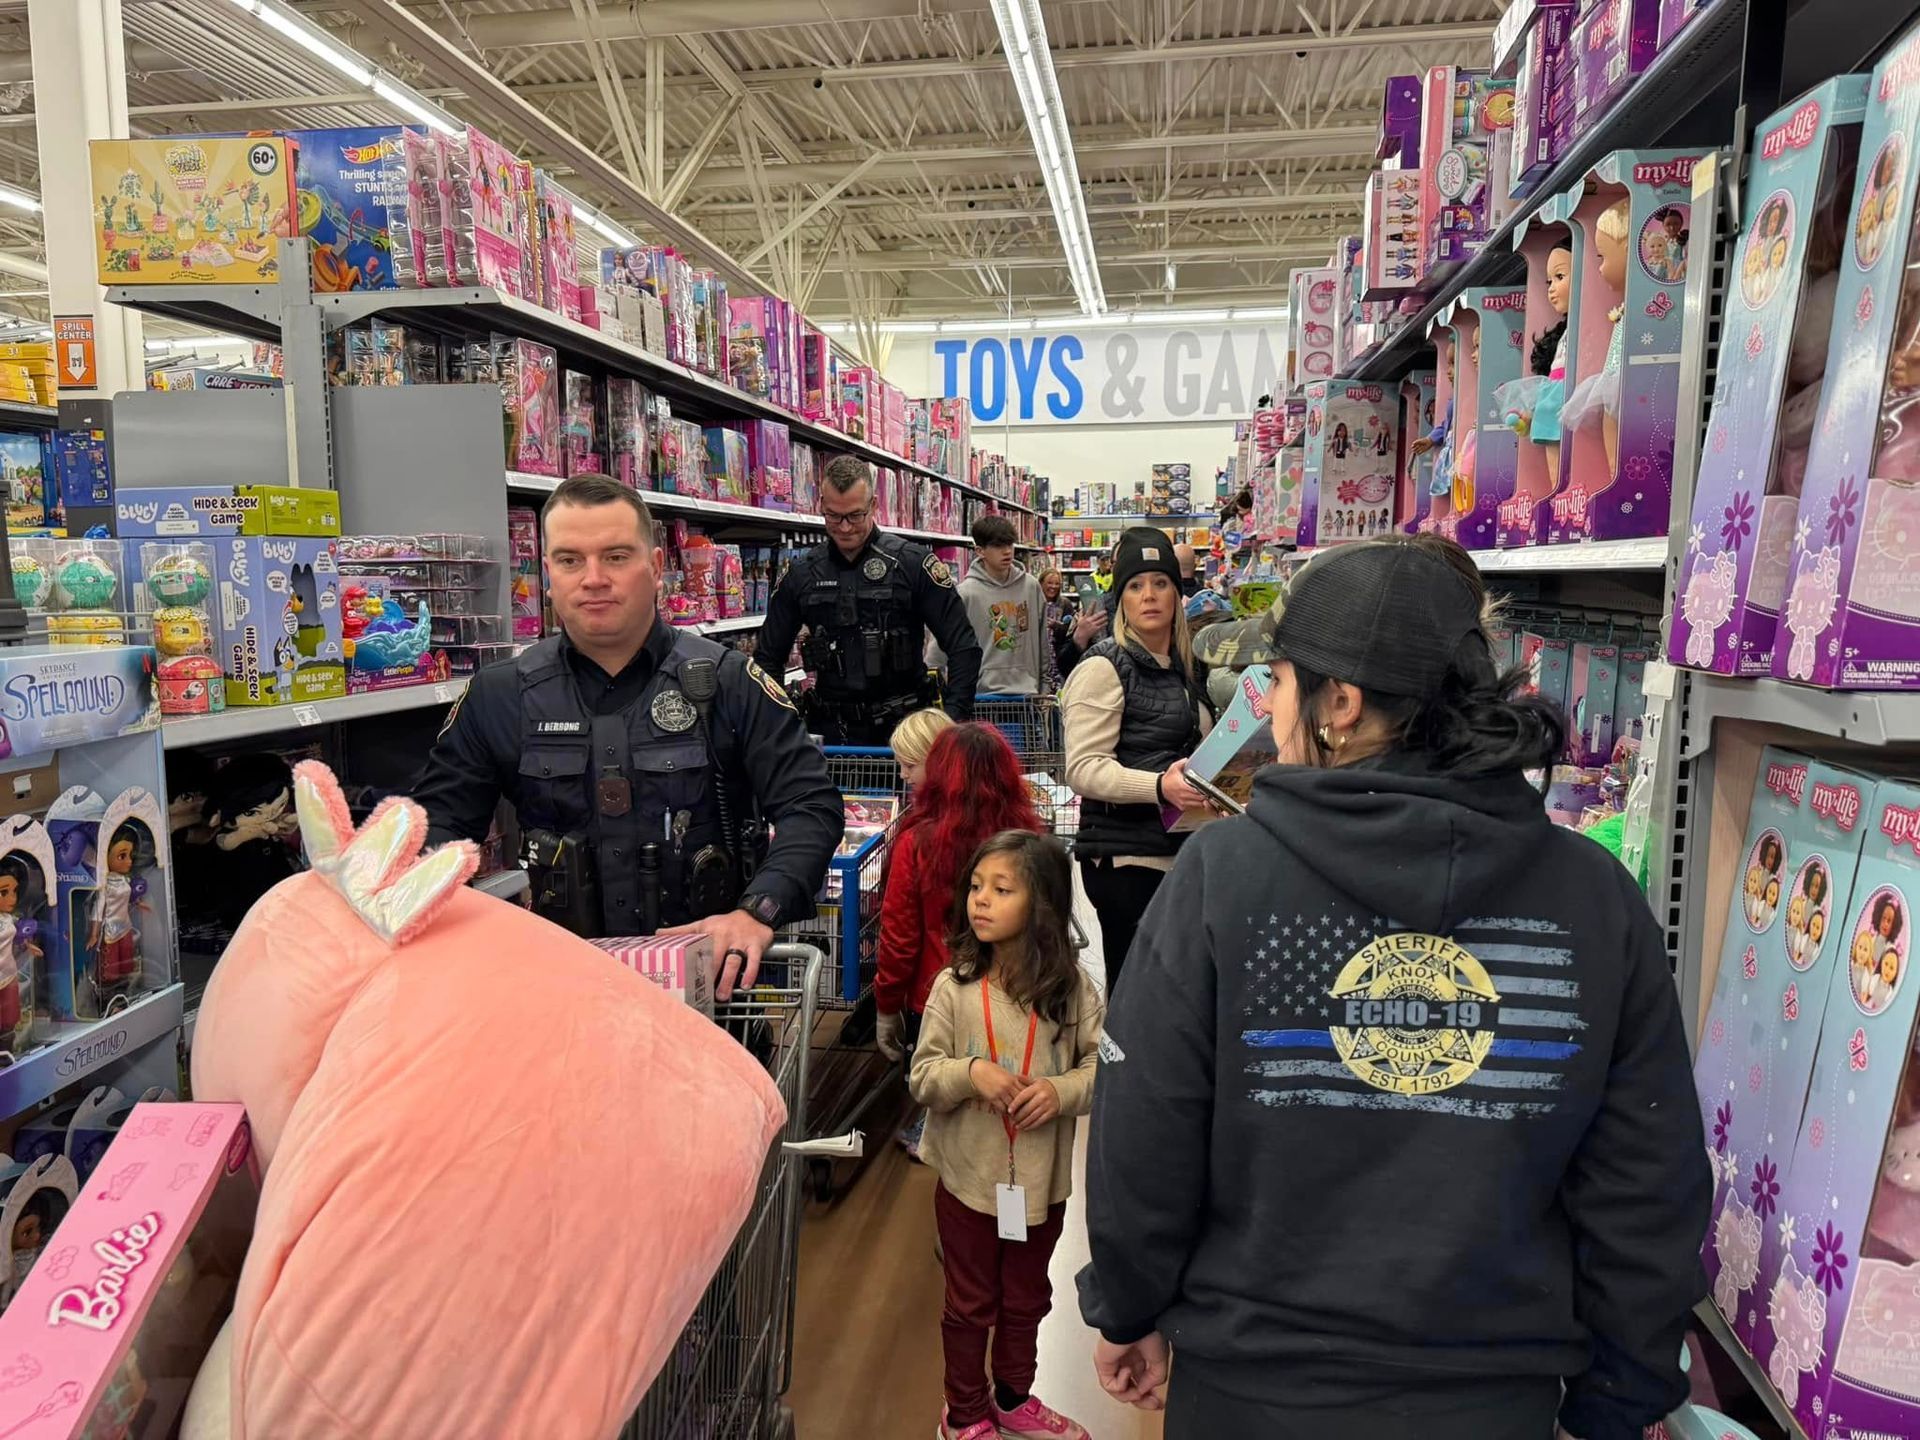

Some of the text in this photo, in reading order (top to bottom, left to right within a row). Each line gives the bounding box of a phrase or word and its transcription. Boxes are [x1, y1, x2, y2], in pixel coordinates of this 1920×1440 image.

[253, 151, 274, 164] 60+
[339, 169, 375, 181] Thrilling
[1676, 160, 1698, 183] lif
[61, 322, 86, 331] SPILL
[57, 331, 92, 340] CENTER
[204, 375, 236, 388] CARE
[935, 335, 1083, 421] TOYS
[1100, 333, 1146, 418] &
[221, 499, 230, 508] &
[1844, 647, 1860, 658] 5+
[40, 663, 77, 674] SKYDANCE
[1867, 662, 1920, 672] WARNING
[1361, 936, 1469, 964] SHERIFF
[1387, 966, 1439, 983] KNOX
[1345, 1001, 1482, 1027] ECHO-19
[1376, 1040, 1445, 1063] COUNTY
[1368, 1069, 1454, 1092] EST. 1792
[49, 1213, 159, 1330] Barbie
